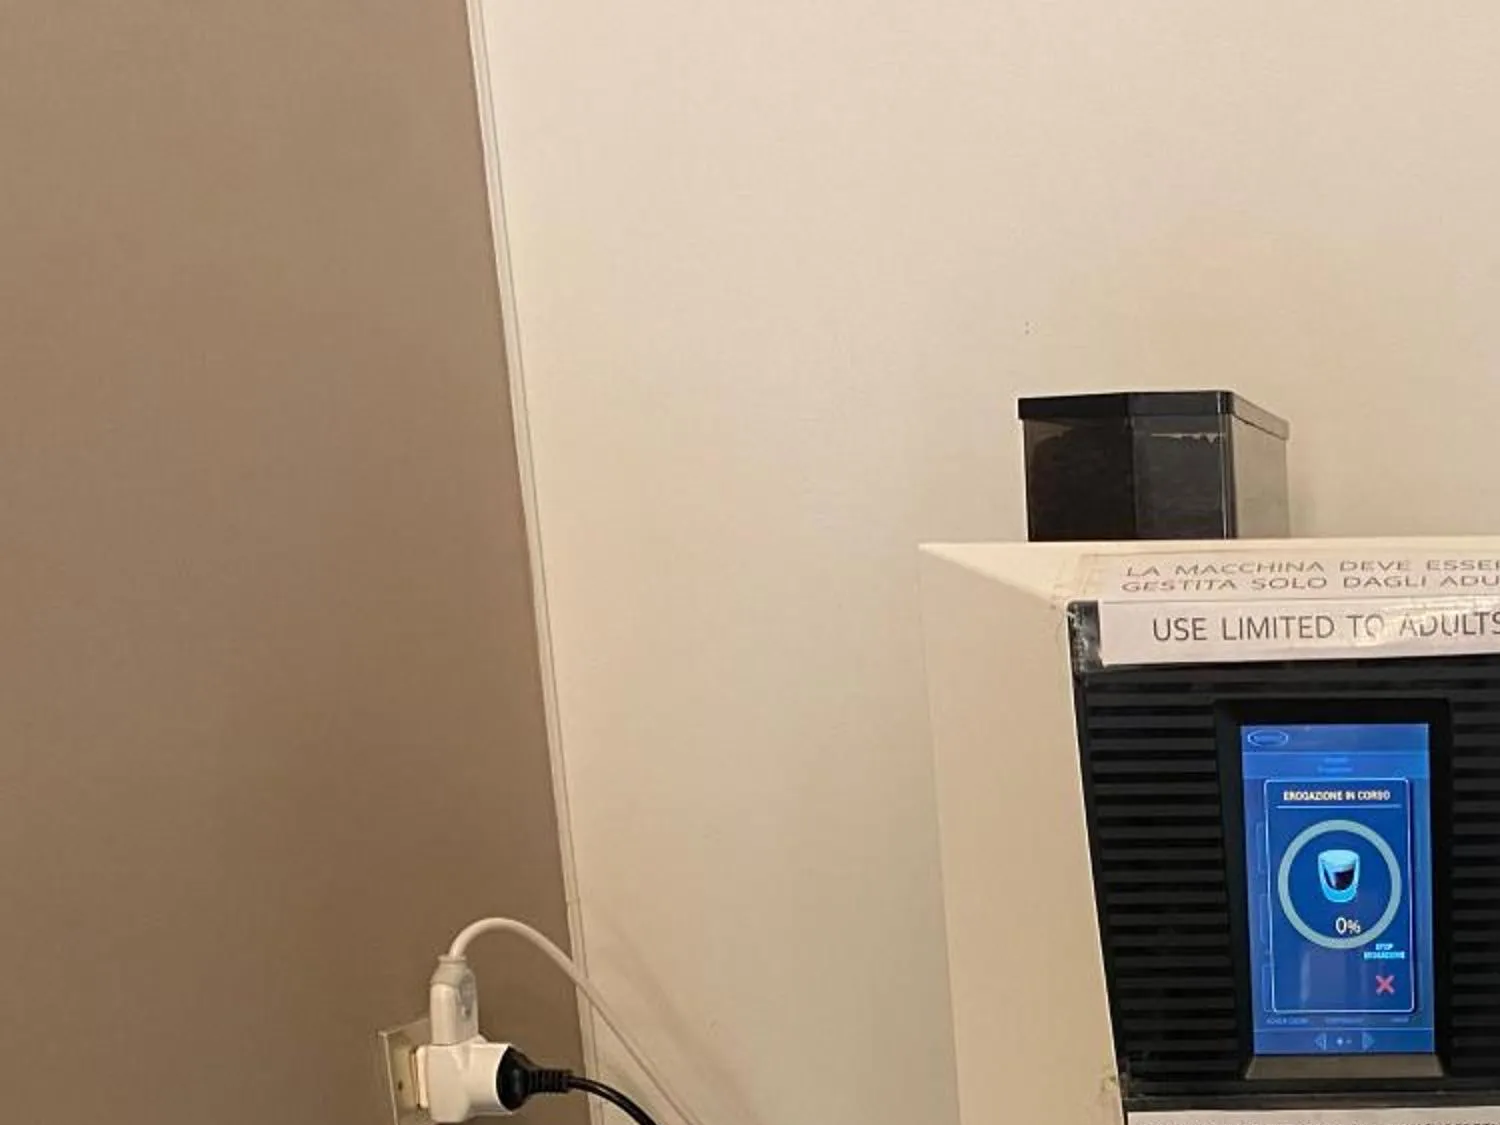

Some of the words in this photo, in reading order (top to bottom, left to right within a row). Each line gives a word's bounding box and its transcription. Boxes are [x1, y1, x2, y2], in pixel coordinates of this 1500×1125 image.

[1126, 565, 1160, 577] LA
[1175, 561, 1325, 576] MACCHINA
[1340, 560, 1410, 572] DEVE
[1121, 579, 1238, 593] GESTITA
[1251, 577, 1328, 590] SOLO
[1344, 575, 1427, 589] DAGLI
[1153, 617, 1208, 642] USE
[1222, 615, 1335, 641] LIMITED
[1346, 614, 1385, 639] TO
[1335, 916, 1361, 935] 0%
